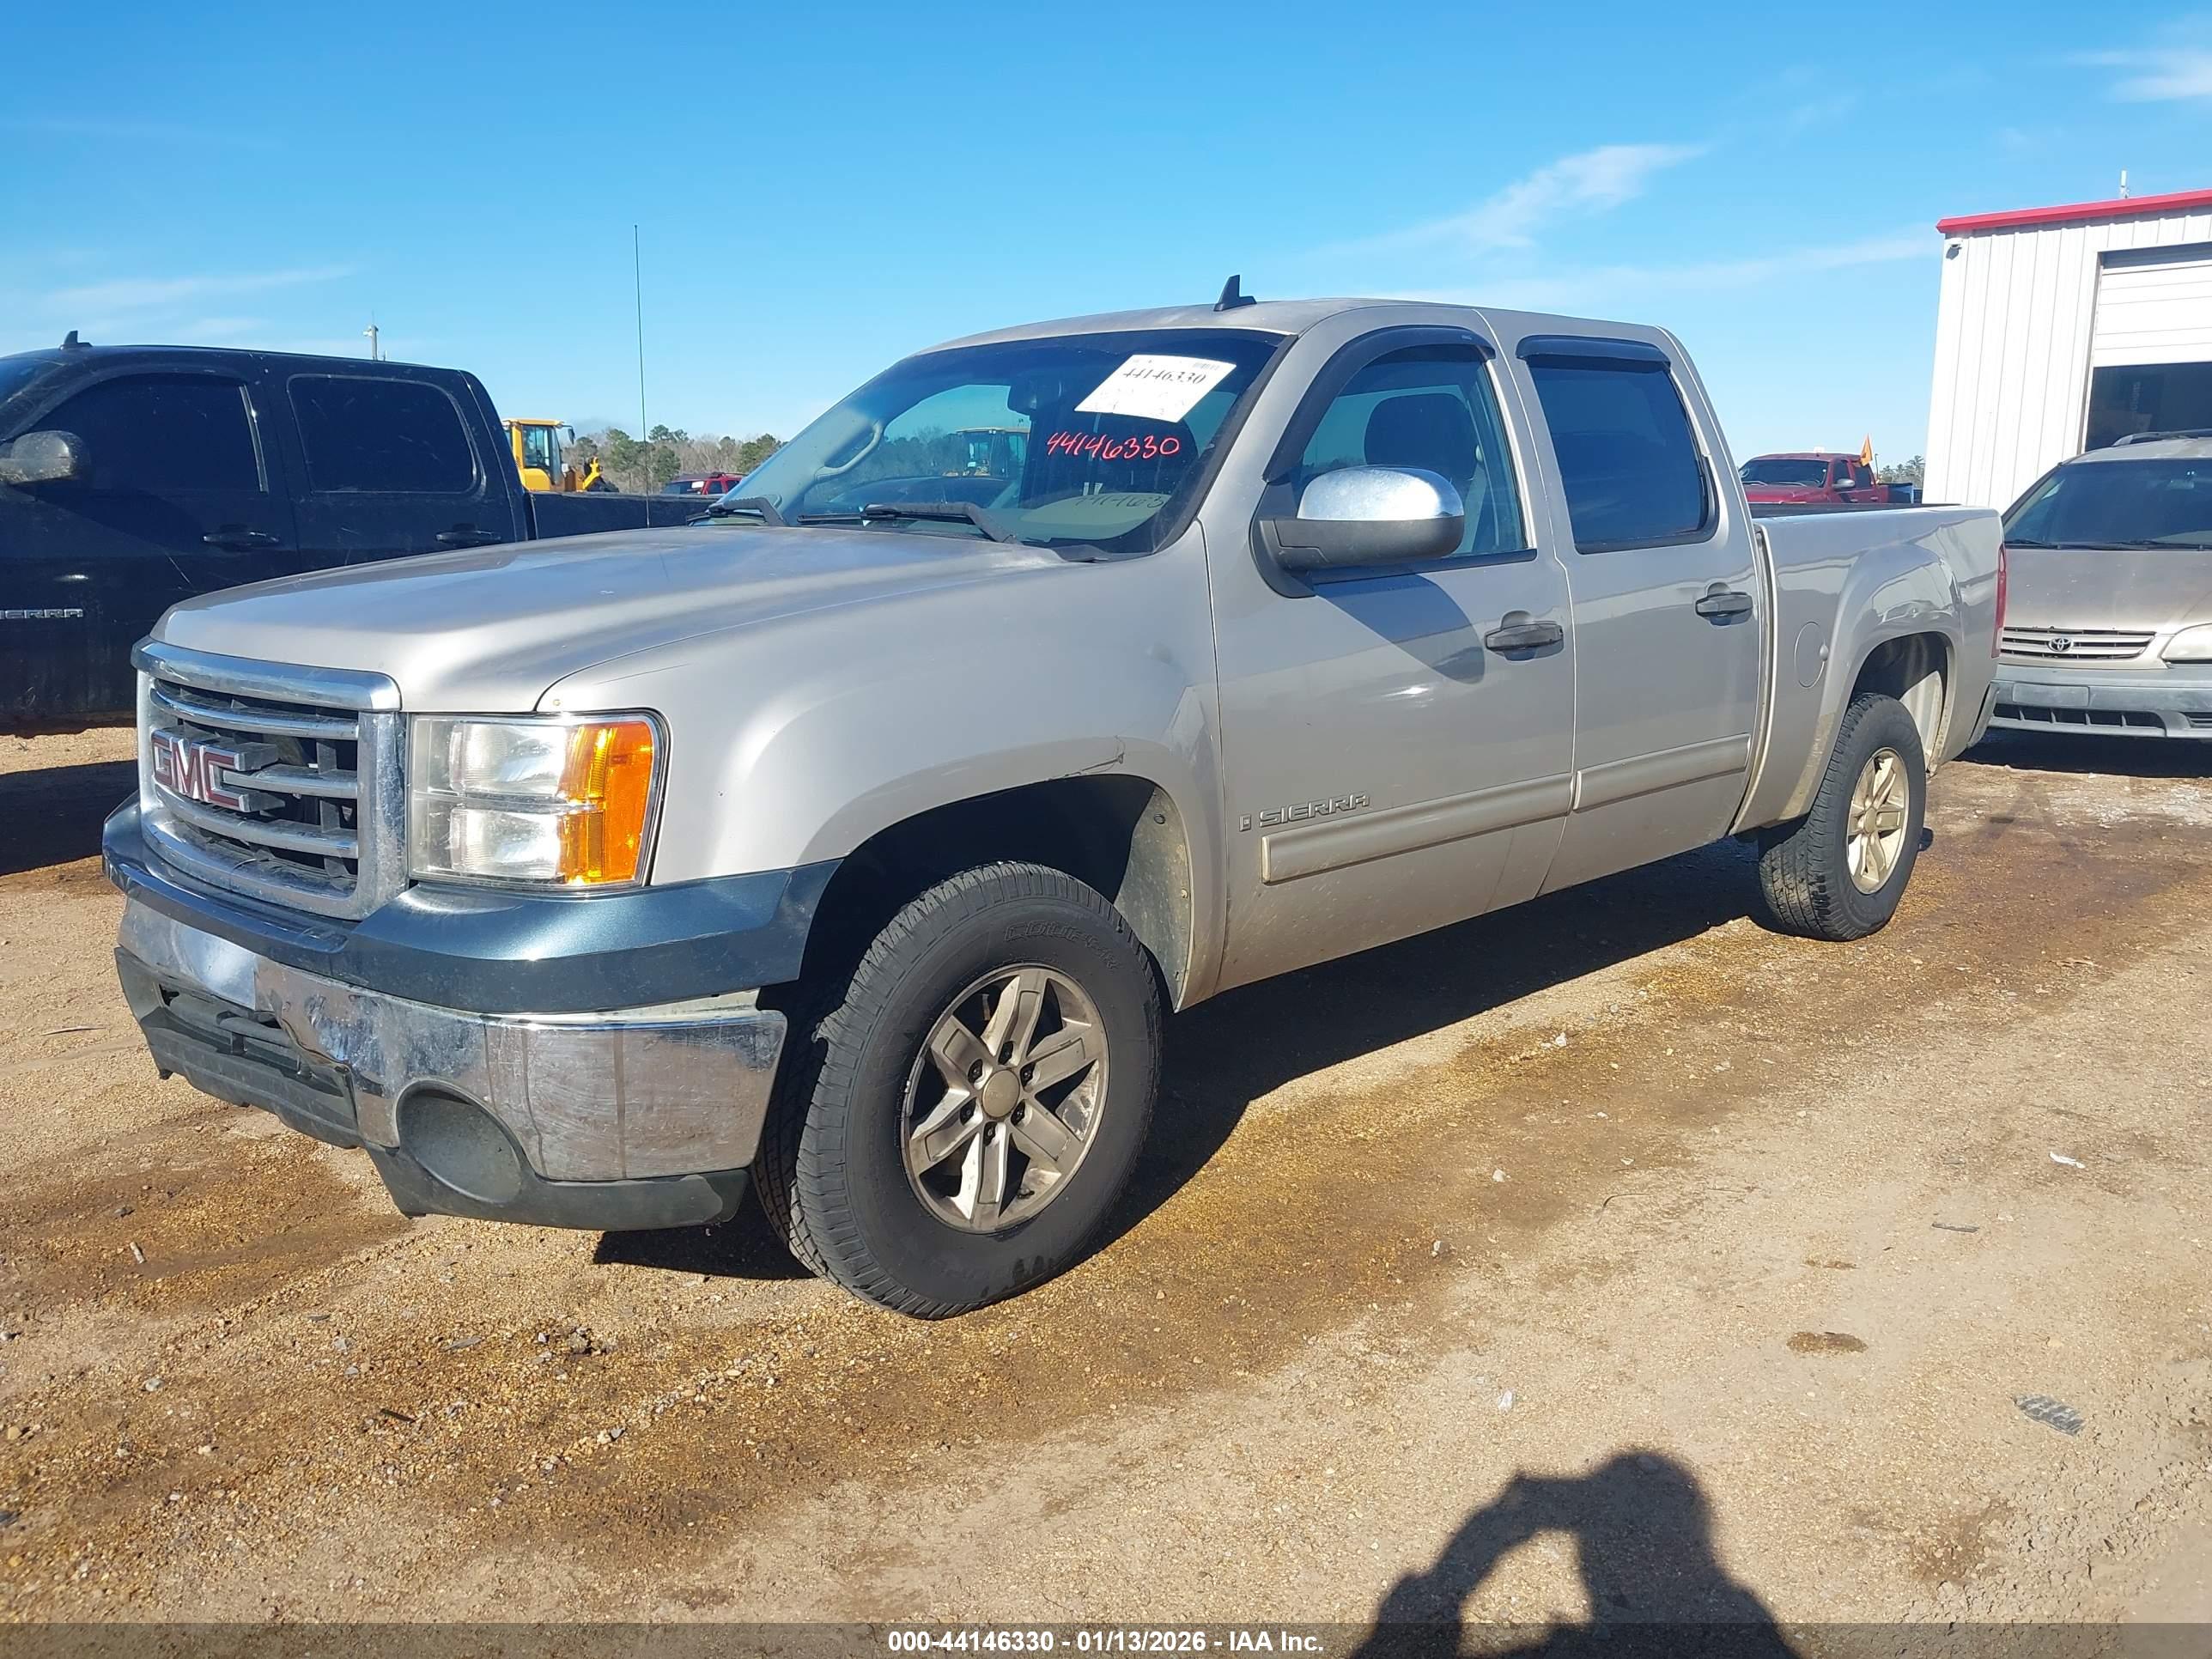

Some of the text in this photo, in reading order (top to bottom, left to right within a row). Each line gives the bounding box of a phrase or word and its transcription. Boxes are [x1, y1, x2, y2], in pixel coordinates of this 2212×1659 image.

[1122, 367, 1206, 385] 44146330
[1046, 431, 1180, 459] 44146330
[0, 608, 83, 619] IERRA
[151, 729, 250, 812] GMC
[1259, 791, 1370, 828] SIERRA
